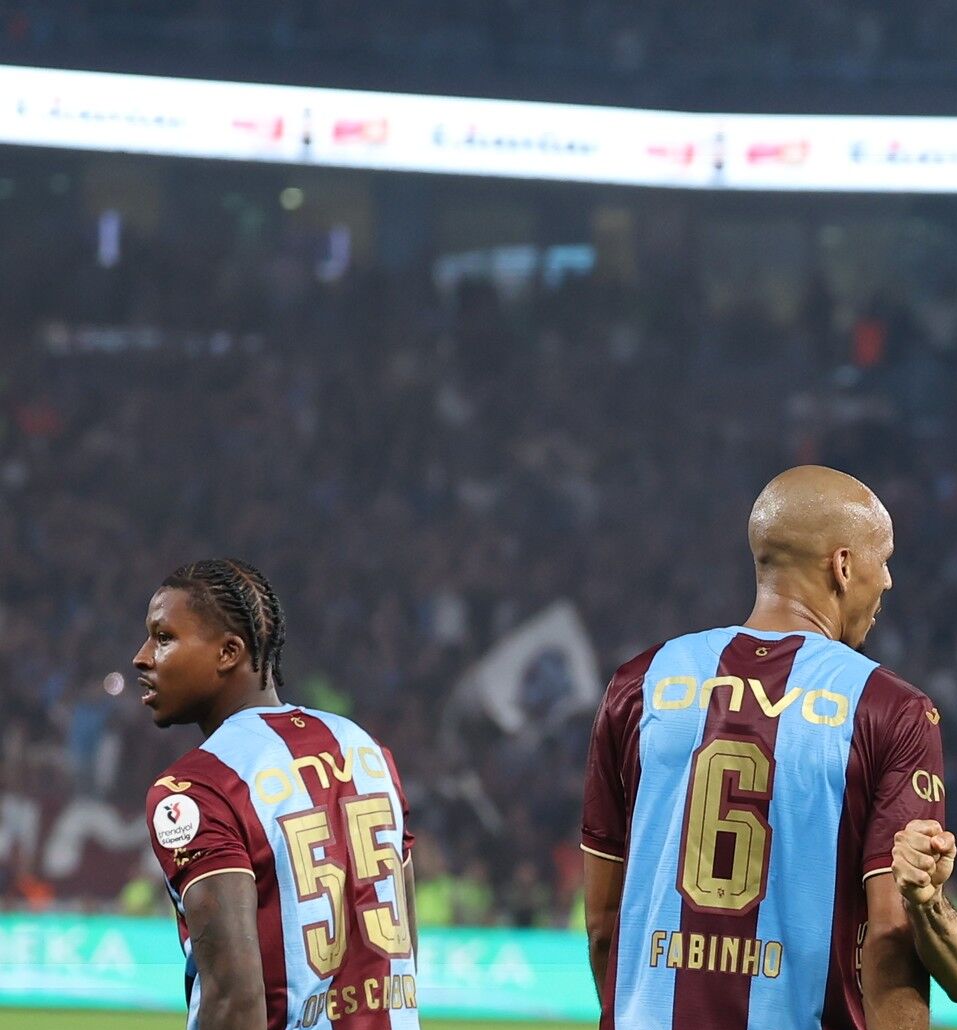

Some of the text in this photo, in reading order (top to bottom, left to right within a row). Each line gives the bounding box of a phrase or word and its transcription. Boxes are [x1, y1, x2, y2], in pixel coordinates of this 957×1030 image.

[652, 675, 849, 727] onvo
[254, 746, 387, 805] onvo
[681, 738, 770, 911] 6
[280, 795, 412, 977] 55
[650, 930, 783, 979] FABINHO
